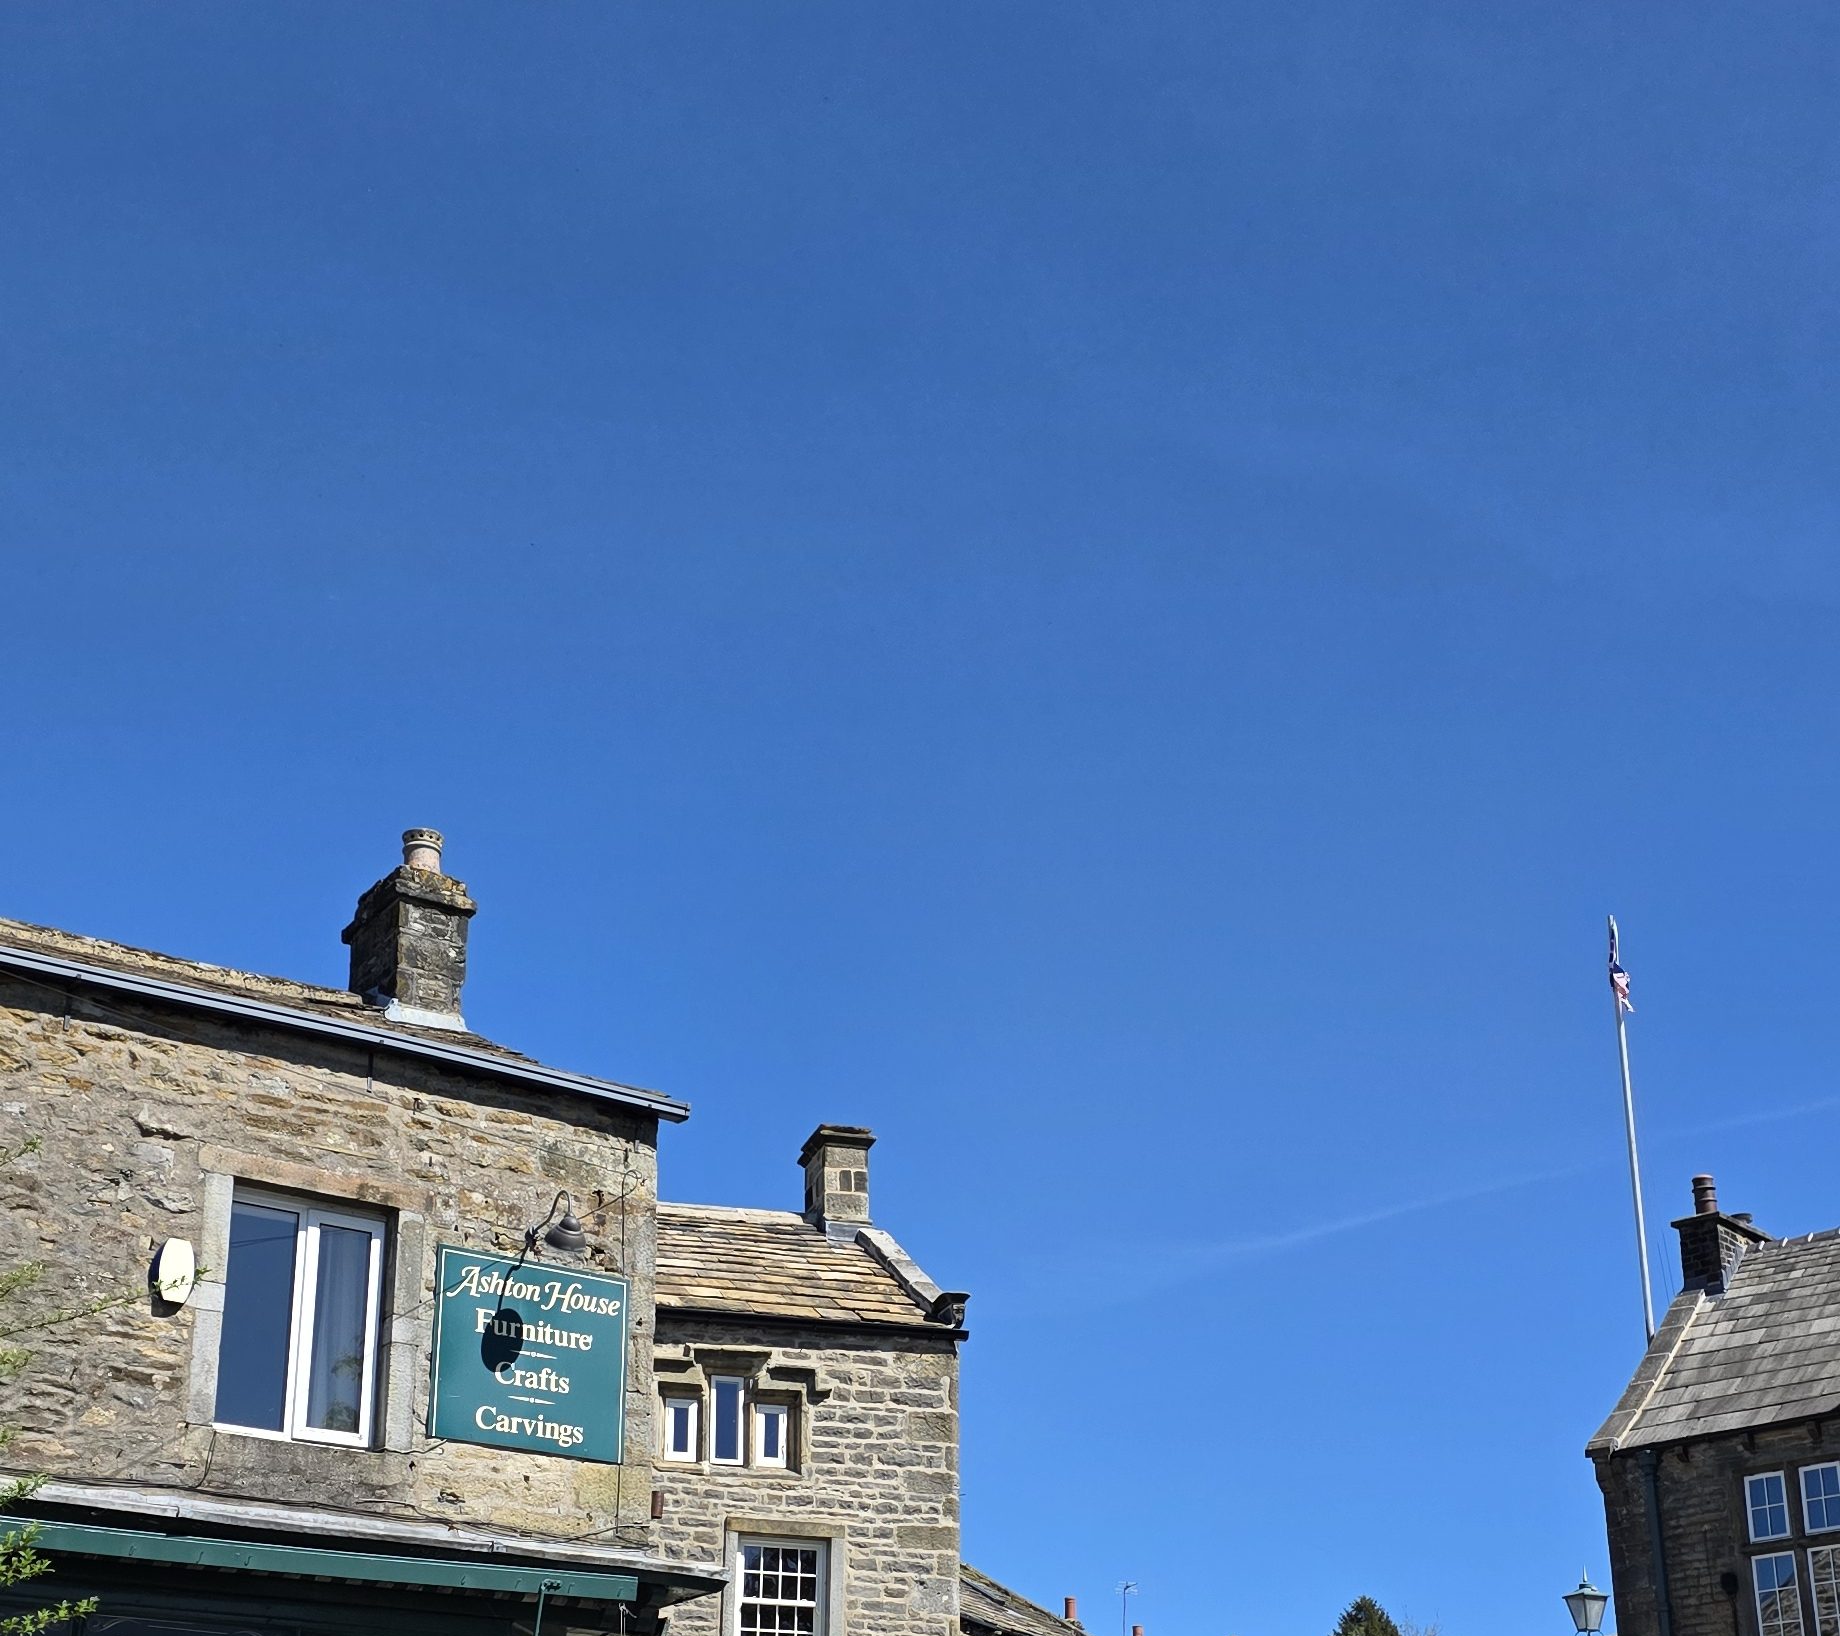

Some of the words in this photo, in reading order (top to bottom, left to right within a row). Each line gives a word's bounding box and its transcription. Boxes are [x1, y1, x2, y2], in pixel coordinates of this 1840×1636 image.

[446, 1265, 540, 1302] Ashton
[541, 1281, 621, 1316] House
[474, 1307, 593, 1350] Furniture
[494, 1361, 570, 1394] Crafts
[475, 1405, 584, 1447] Carvings
